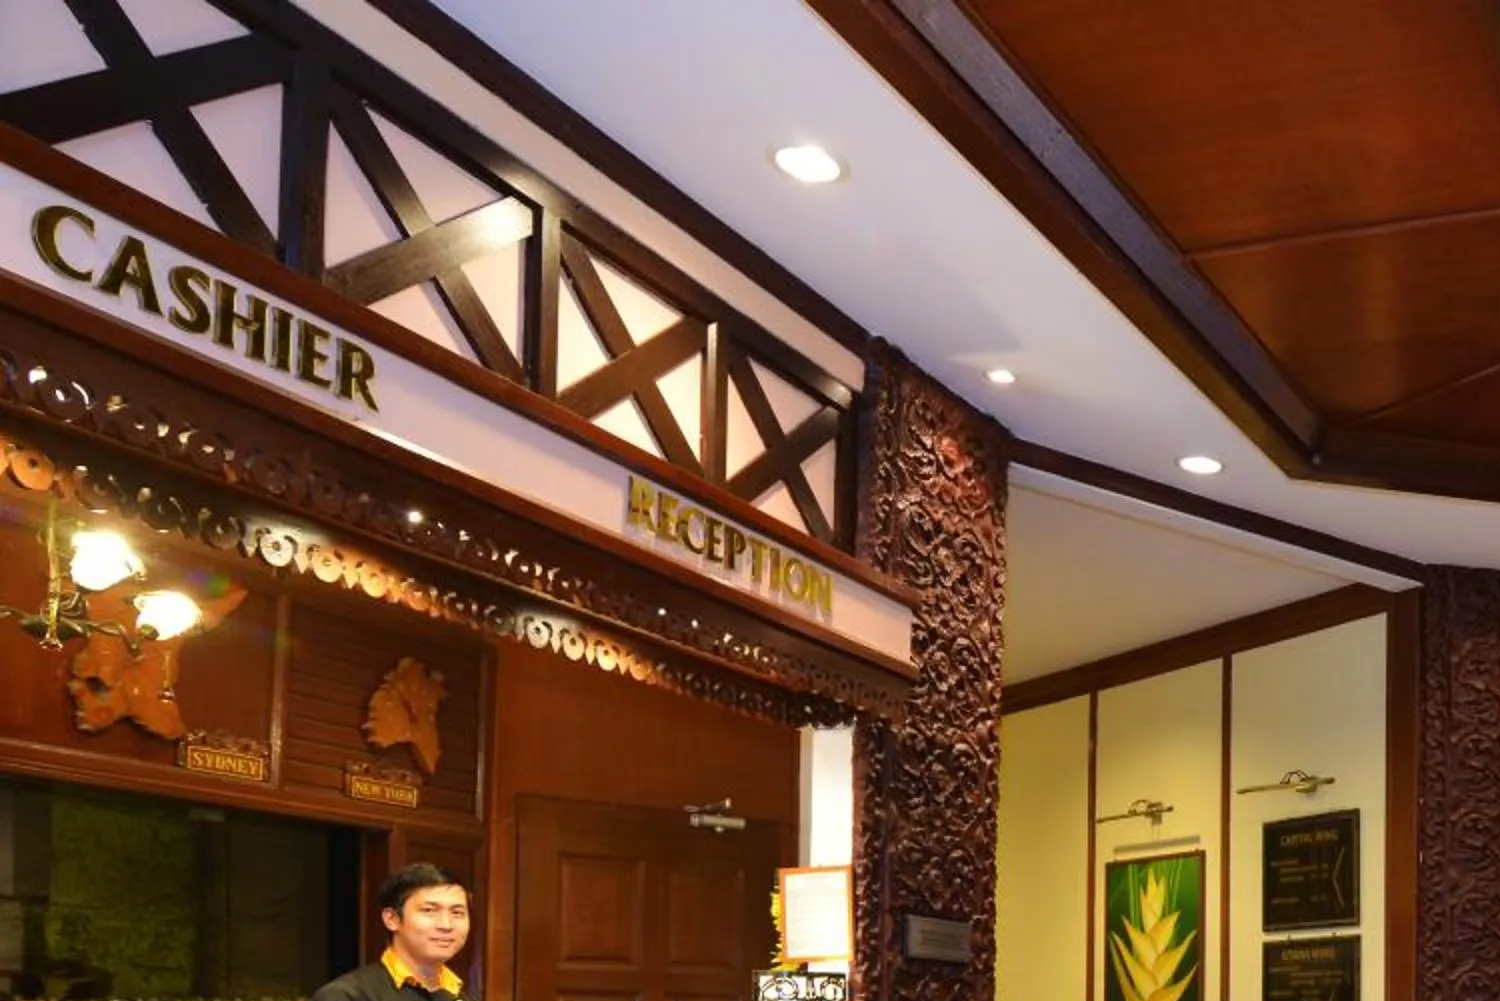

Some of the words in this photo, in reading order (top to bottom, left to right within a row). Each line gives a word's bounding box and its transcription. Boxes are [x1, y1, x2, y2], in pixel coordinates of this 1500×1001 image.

[32, 205, 379, 412] CASHIER
[628, 475, 834, 614] RECEPTION
[192, 751, 260, 776] SYDNEY
